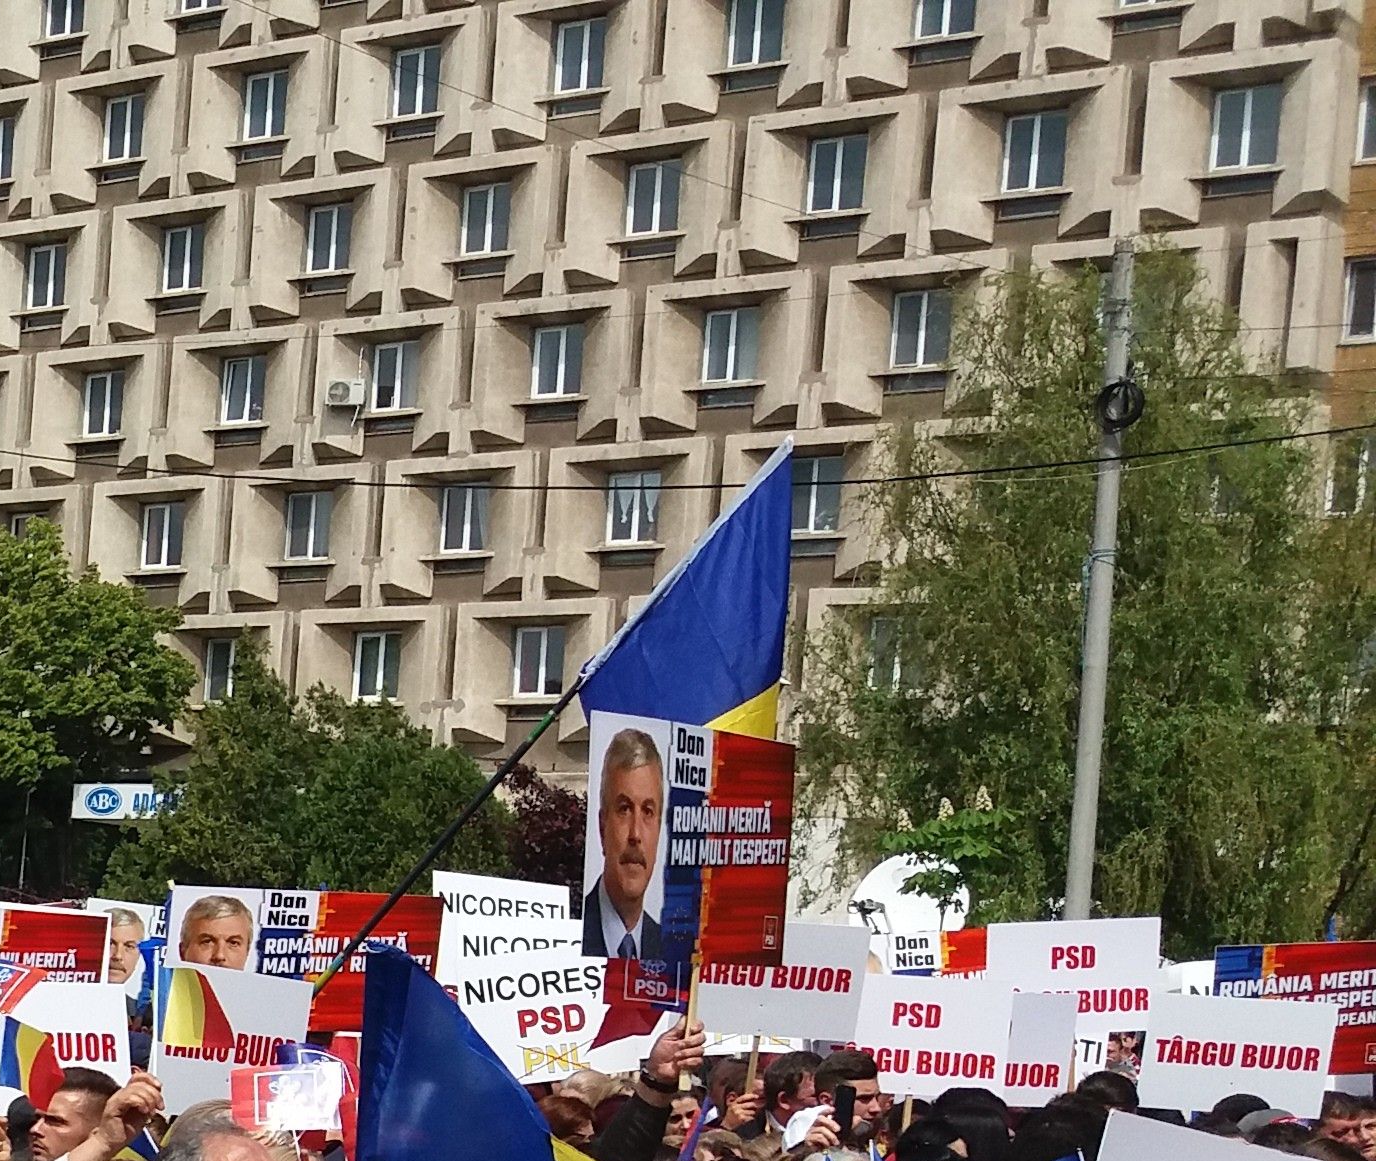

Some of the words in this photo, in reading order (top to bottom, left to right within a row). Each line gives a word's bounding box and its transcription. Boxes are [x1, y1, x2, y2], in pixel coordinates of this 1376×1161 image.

[676, 728, 705, 757] Dan
[674, 758, 707, 787] Nica
[89, 793, 118, 810] ABC
[672, 800, 726, 834] ROMÂNII
[728, 800, 772, 834] MERITĂ
[670, 839, 697, 867] MAI
[699, 838, 731, 867] MULT
[732, 838, 788, 867] RESPECT!
[269, 891, 307, 909] Dan
[266, 909, 310, 928] Nica
[264, 933, 342, 955] ROMÂNII
[894, 936, 930, 951] Dan
[22, 948, 78, 969] MERITĂ
[262, 956, 297, 974] MAI
[299, 956, 343, 974] MUL
[895, 953, 935, 968] Nica
[1050, 945, 1097, 970] PSD
[464, 965, 606, 1006] NICOREȘ
[634, 979, 668, 998] PSD
[771, 965, 853, 993] BUJOR
[1219, 973, 1314, 998] ROMÂNIA
[1077, 987, 1150, 1015] BUJOR
[517, 1003, 586, 1038] PSD
[891, 1002, 943, 1028] PSD
[522, 1042, 591, 1077] PNL
[915, 1050, 996, 1079] BUJOR
[1155, 1035, 1239, 1067] TÂRGU
[1240, 1044, 1321, 1072] BUJOR
